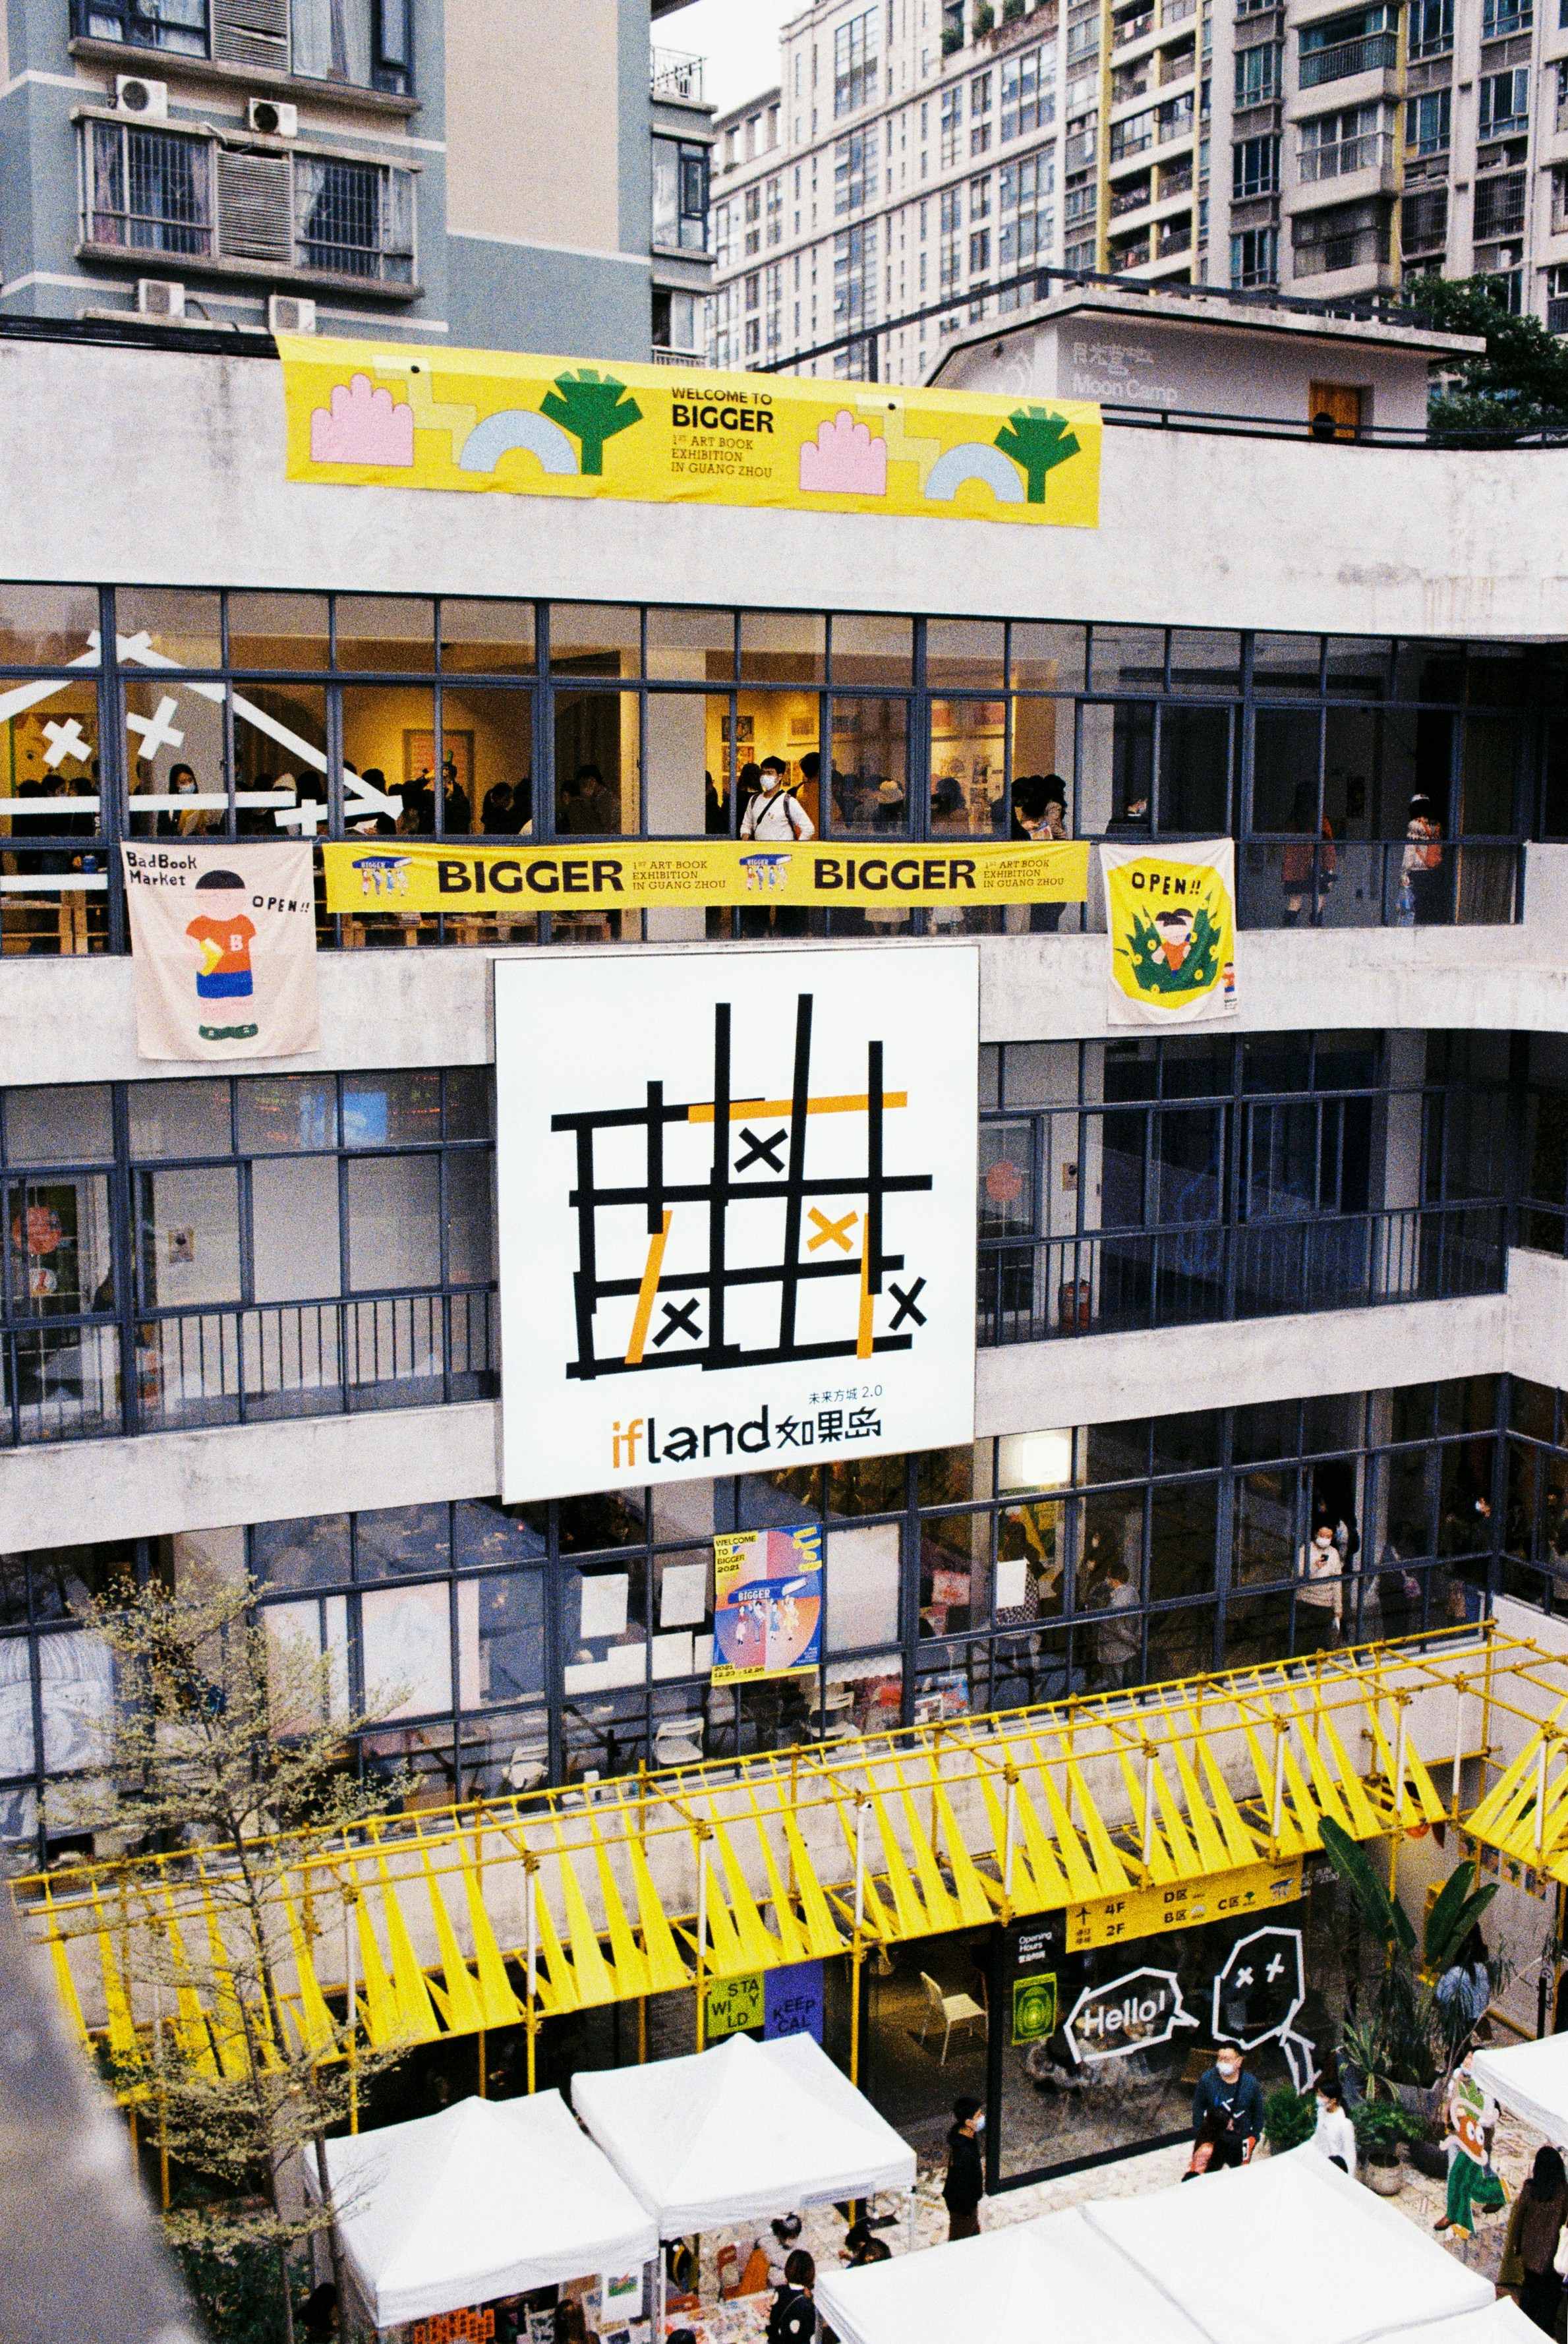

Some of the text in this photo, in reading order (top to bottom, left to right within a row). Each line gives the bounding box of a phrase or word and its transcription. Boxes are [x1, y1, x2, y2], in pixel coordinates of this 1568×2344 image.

[672, 387, 772, 405] WELCOME TO
[1073, 373, 1178, 406] Moon Camp
[672, 404, 774, 433] BIGGER
[691, 436, 715, 447] ART
[719, 437, 753, 450] BOOK
[672, 448, 742, 461] EXHIBITION
[671, 462, 772, 478] IN GUANG ZHOU
[438, 860, 625, 893] BIGGER
[633, 871, 698, 880] EXHIBITION
[814, 858, 976, 891] BIGGER
[983, 869, 1041, 878] EXHIBITION
[694, 880, 726, 889] ZHOU
[997, 879, 1034, 887] GUANG
[1132, 872, 1201, 895] OPEN!!
[230, 934, 243, 951] B
[809, 1384, 883, 1405] 未来方城 2.0
[612, 1404, 882, 1469] ifland 如果岛
[716, 1535, 756, 1546] WELCOME
[717, 1554, 745, 1564] BIGGER
[717, 1564, 740, 1573] 2021
[738, 1589, 770, 1601] BIGGER
[1105, 1901, 1126, 1915] 4F
[1106, 1923, 1125, 1937] 2F
[1019, 1931, 1053, 1945] Opening
[1020, 1942, 1043, 1952] Hours
